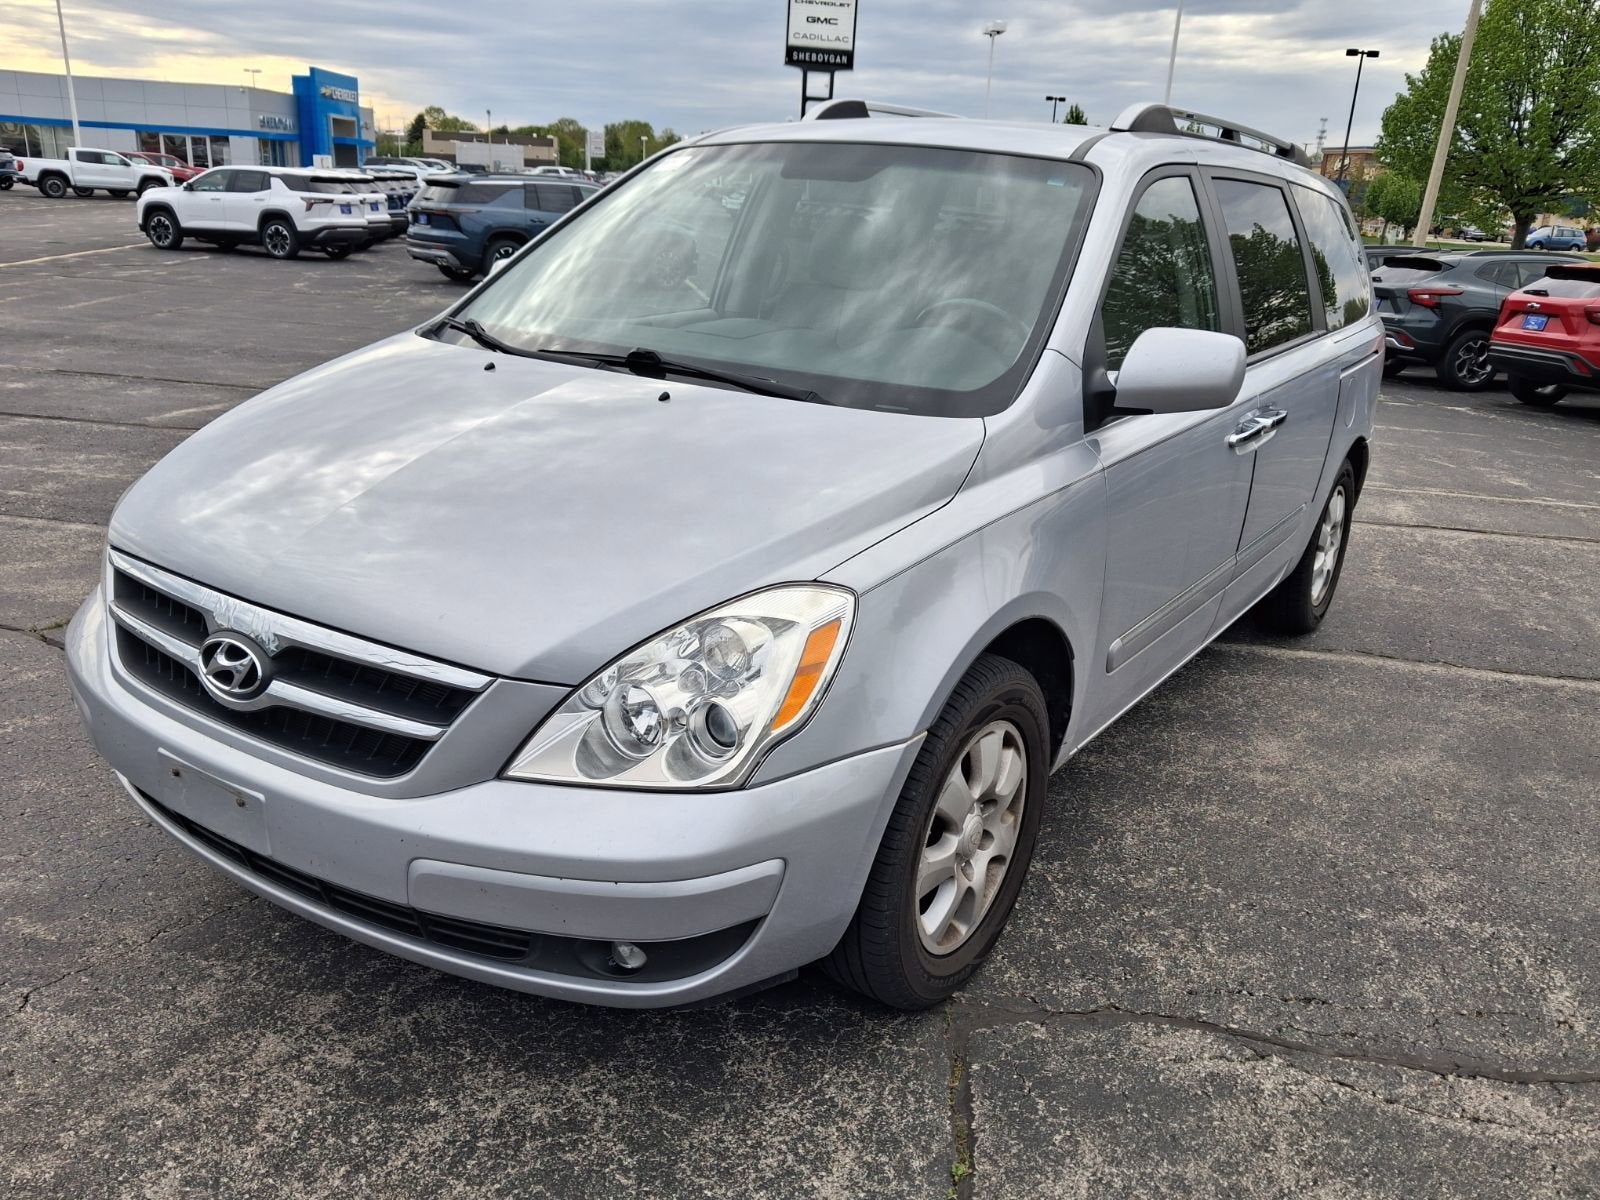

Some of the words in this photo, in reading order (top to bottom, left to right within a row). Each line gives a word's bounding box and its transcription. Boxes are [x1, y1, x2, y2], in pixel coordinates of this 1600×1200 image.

[806, 16, 839, 25] GMC
[793, 32, 849, 43] CADILLAC
[792, 51, 848, 64] SHEBOYGAN
